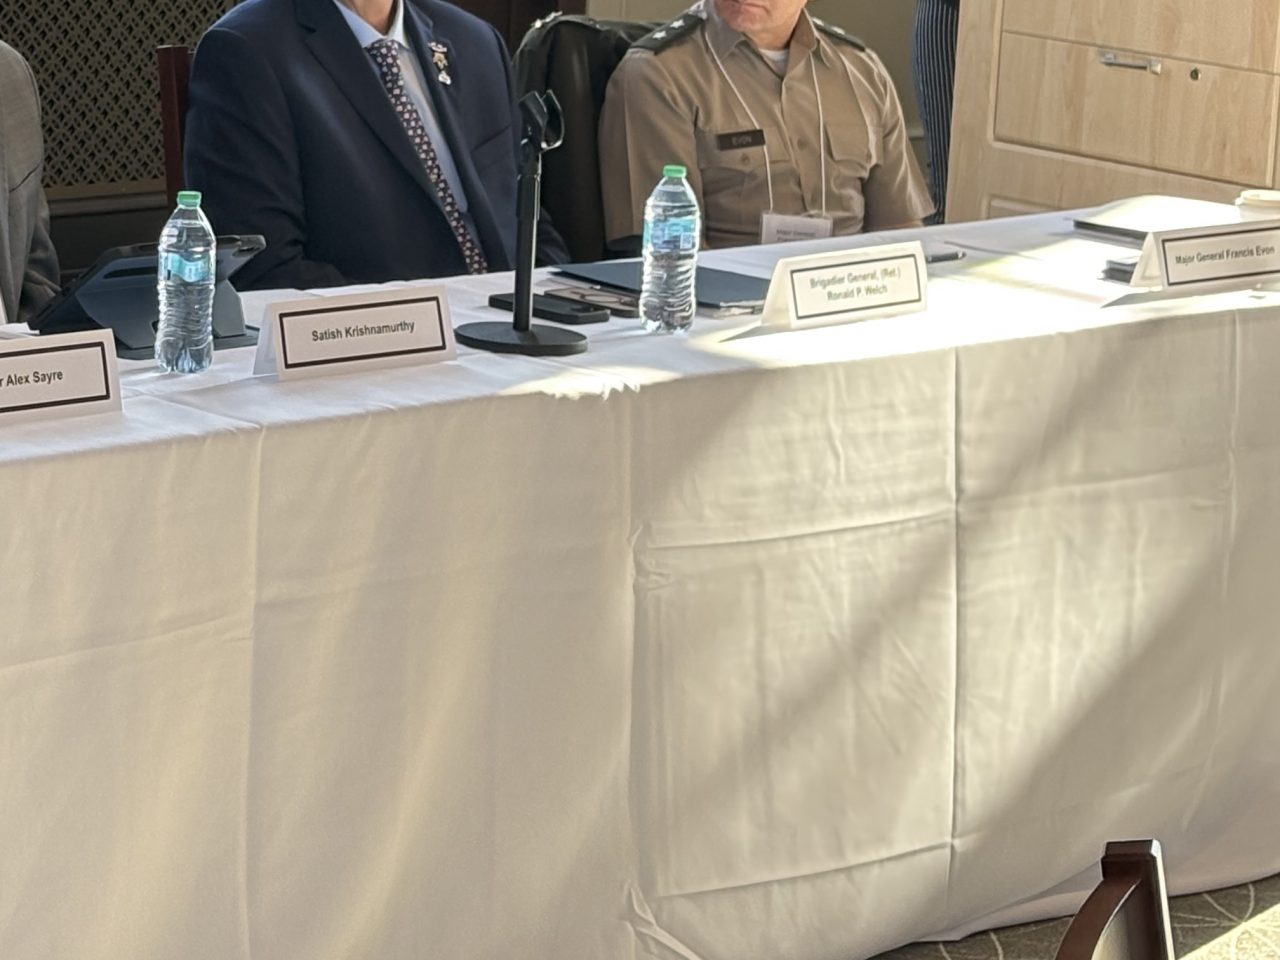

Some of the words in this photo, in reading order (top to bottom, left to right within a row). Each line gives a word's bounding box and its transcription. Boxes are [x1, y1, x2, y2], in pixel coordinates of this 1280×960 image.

[1175, 255, 1196, 266] Major
[1196, 250, 1225, 263] General
[1226, 246, 1254, 259] Francis
[1255, 245, 1275, 256] Evon
[810, 275, 845, 290] Brigadier
[827, 289, 855, 301] Ronald
[864, 284, 888, 296] Welch
[311, 328, 343, 342] Satish
[345, 320, 415, 338] Krishnamurthy
[6, 373, 30, 388] Alex
[32, 370, 64, 385] Sayre
